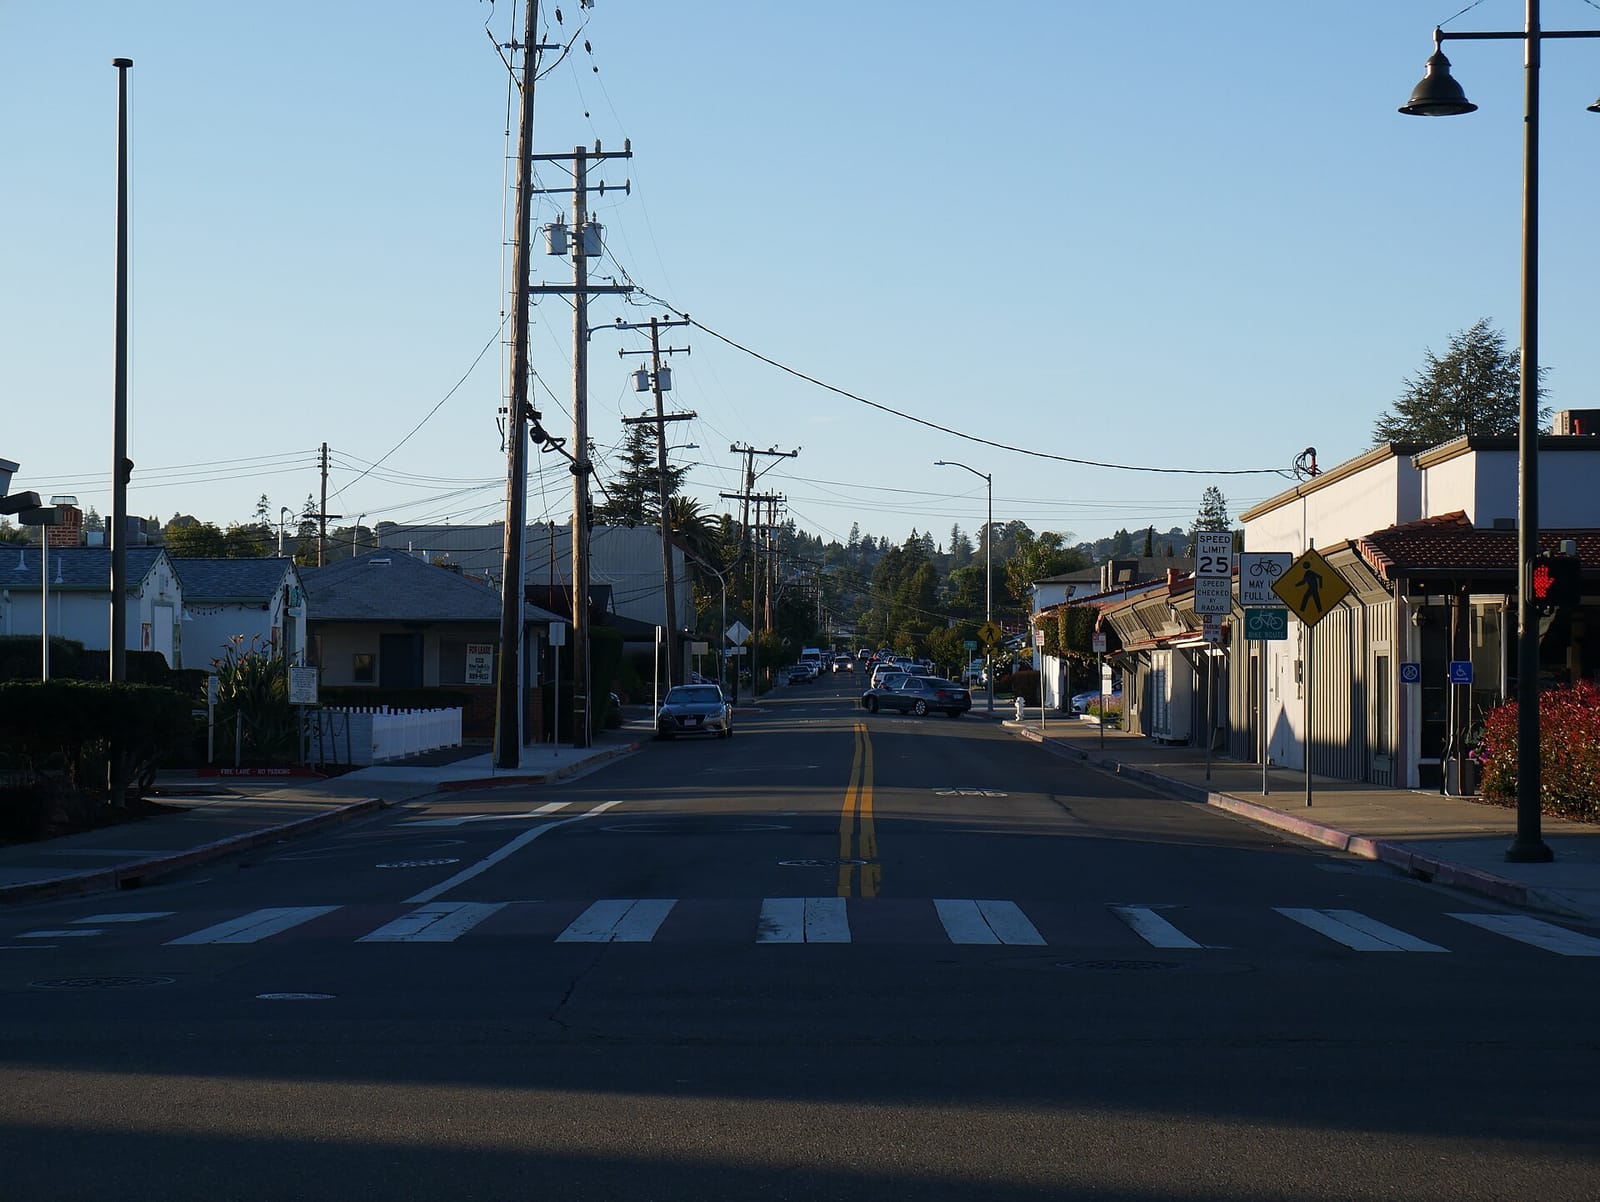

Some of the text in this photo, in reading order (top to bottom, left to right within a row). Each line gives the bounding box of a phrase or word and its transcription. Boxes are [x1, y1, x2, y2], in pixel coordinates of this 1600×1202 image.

[1199, 535, 1231, 544] SPEED
[1199, 556, 1229, 573] 25
[1202, 580, 1225, 588] SPEED
[1249, 580, 1264, 588] MAY
[1197, 589, 1229, 597] CHECKED
[1244, 591, 1264, 601] FULL
[1201, 604, 1225, 612] RADAR
[1248, 631, 1286, 639] BIKE ROUTE
[258, 768, 266, 776] NO
